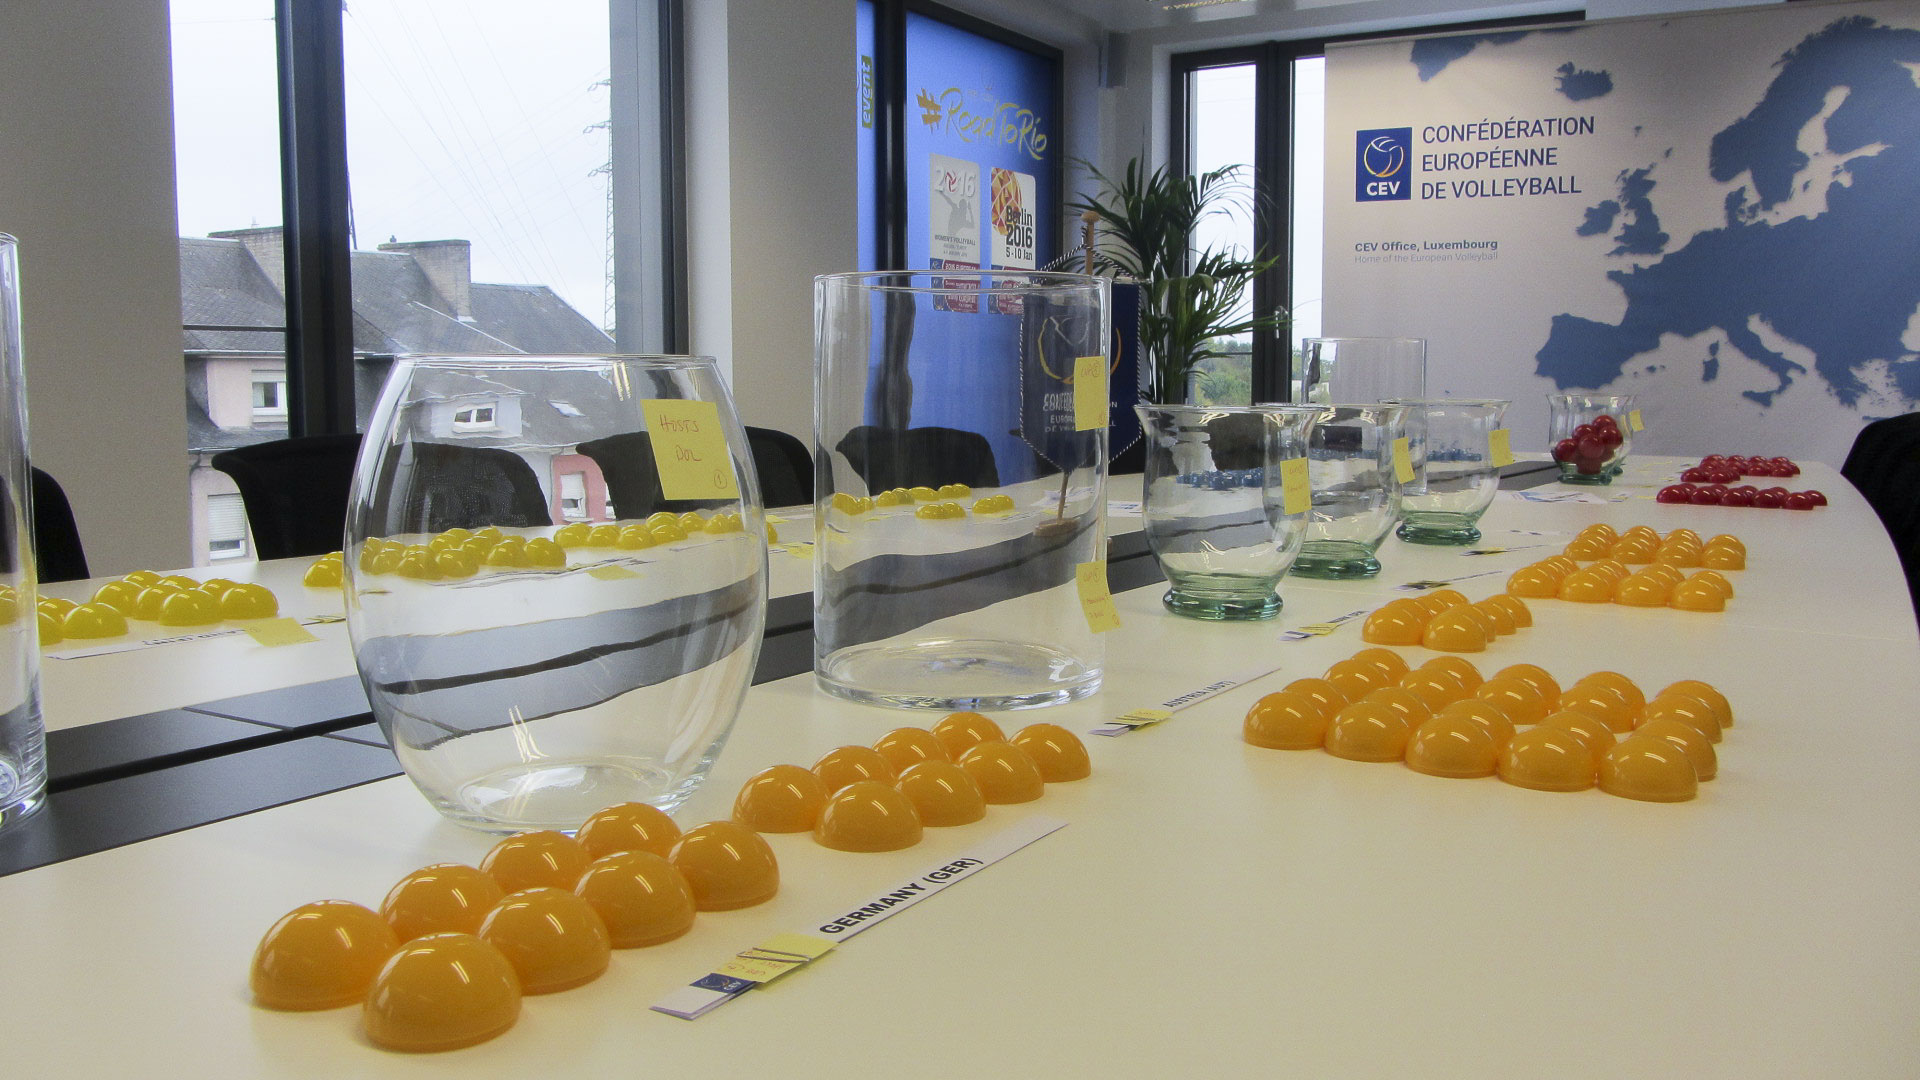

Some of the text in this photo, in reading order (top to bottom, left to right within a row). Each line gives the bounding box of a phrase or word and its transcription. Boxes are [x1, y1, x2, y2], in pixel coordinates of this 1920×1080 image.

[862, 61, 872, 124] event
[1422, 116, 1595, 144] CONFÉDÉRATION
[1422, 146, 1558, 172] EUROPÉENNE
[1366, 181, 1401, 196] CEV
[1421, 175, 1582, 200] DE VOLLEYBALL
[1006, 205, 1033, 227] Berlin
[1006, 226, 1033, 249] 2016
[1354, 240, 1499, 252] CEV Office, Luxembourg
[1355, 251, 1499, 264] Home of the European Volleyball
[819, 857, 984, 934] GERMANY (GER)
